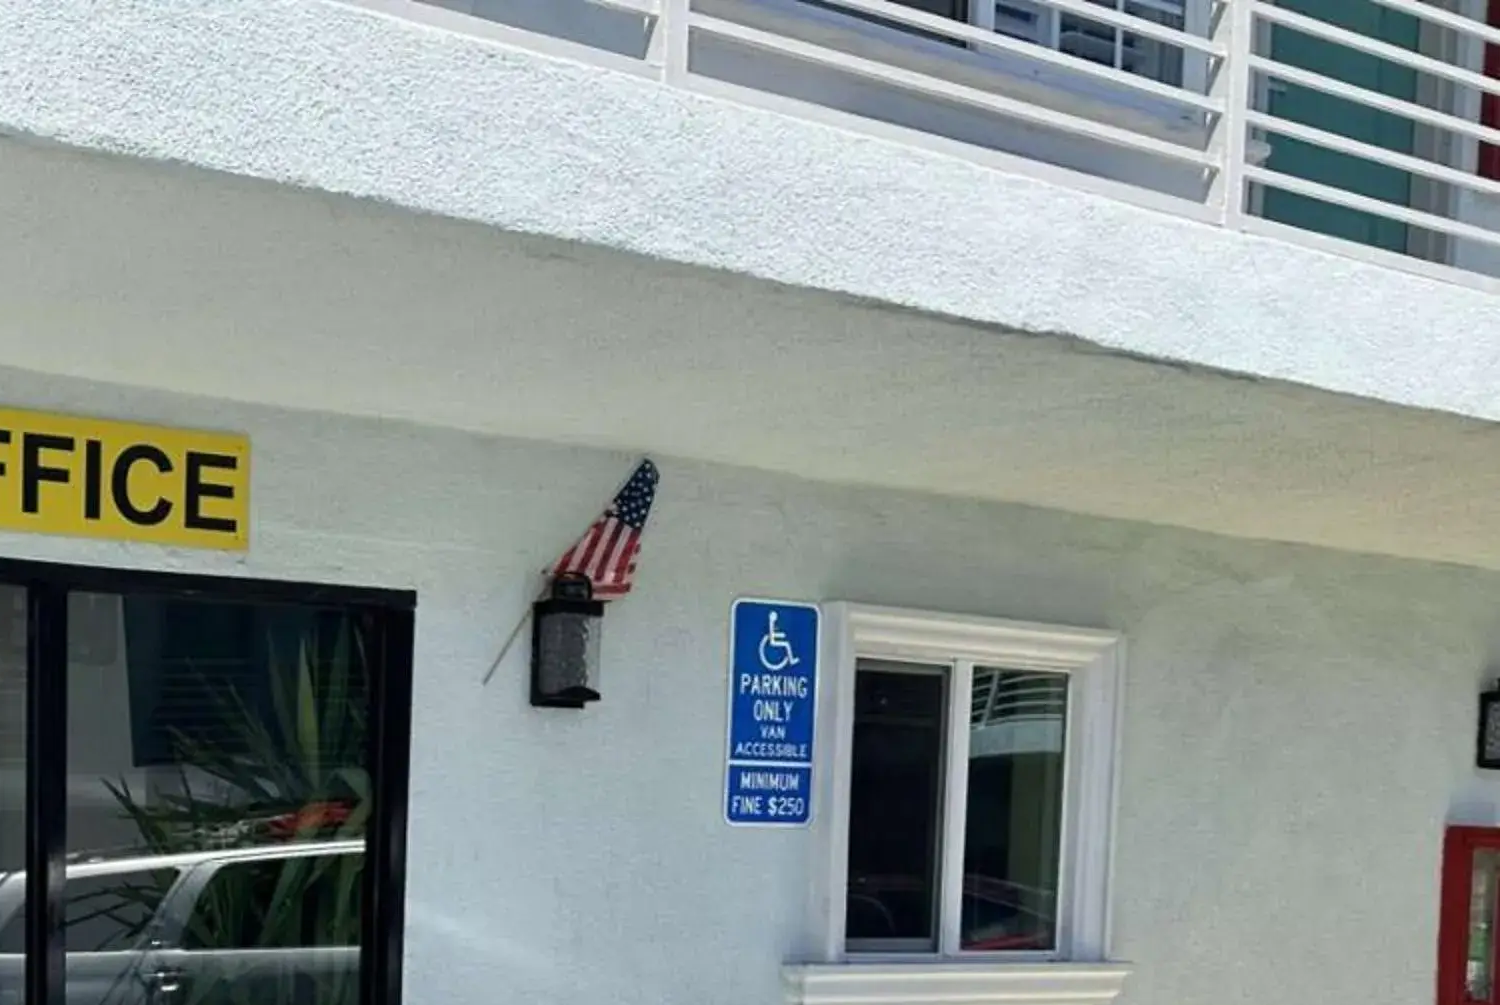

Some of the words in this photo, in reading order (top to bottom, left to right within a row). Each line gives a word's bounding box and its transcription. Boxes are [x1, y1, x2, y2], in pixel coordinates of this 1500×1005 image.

[740, 673, 808, 698] PARKING
[753, 702, 794, 723] ONLY
[760, 725, 785, 741] VAN
[734, 742, 807, 758] ACCESSIBLE
[740, 772, 799, 791] MINIMUM
[732, 795, 763, 815] FINE
[767, 796, 805, 817] $250
